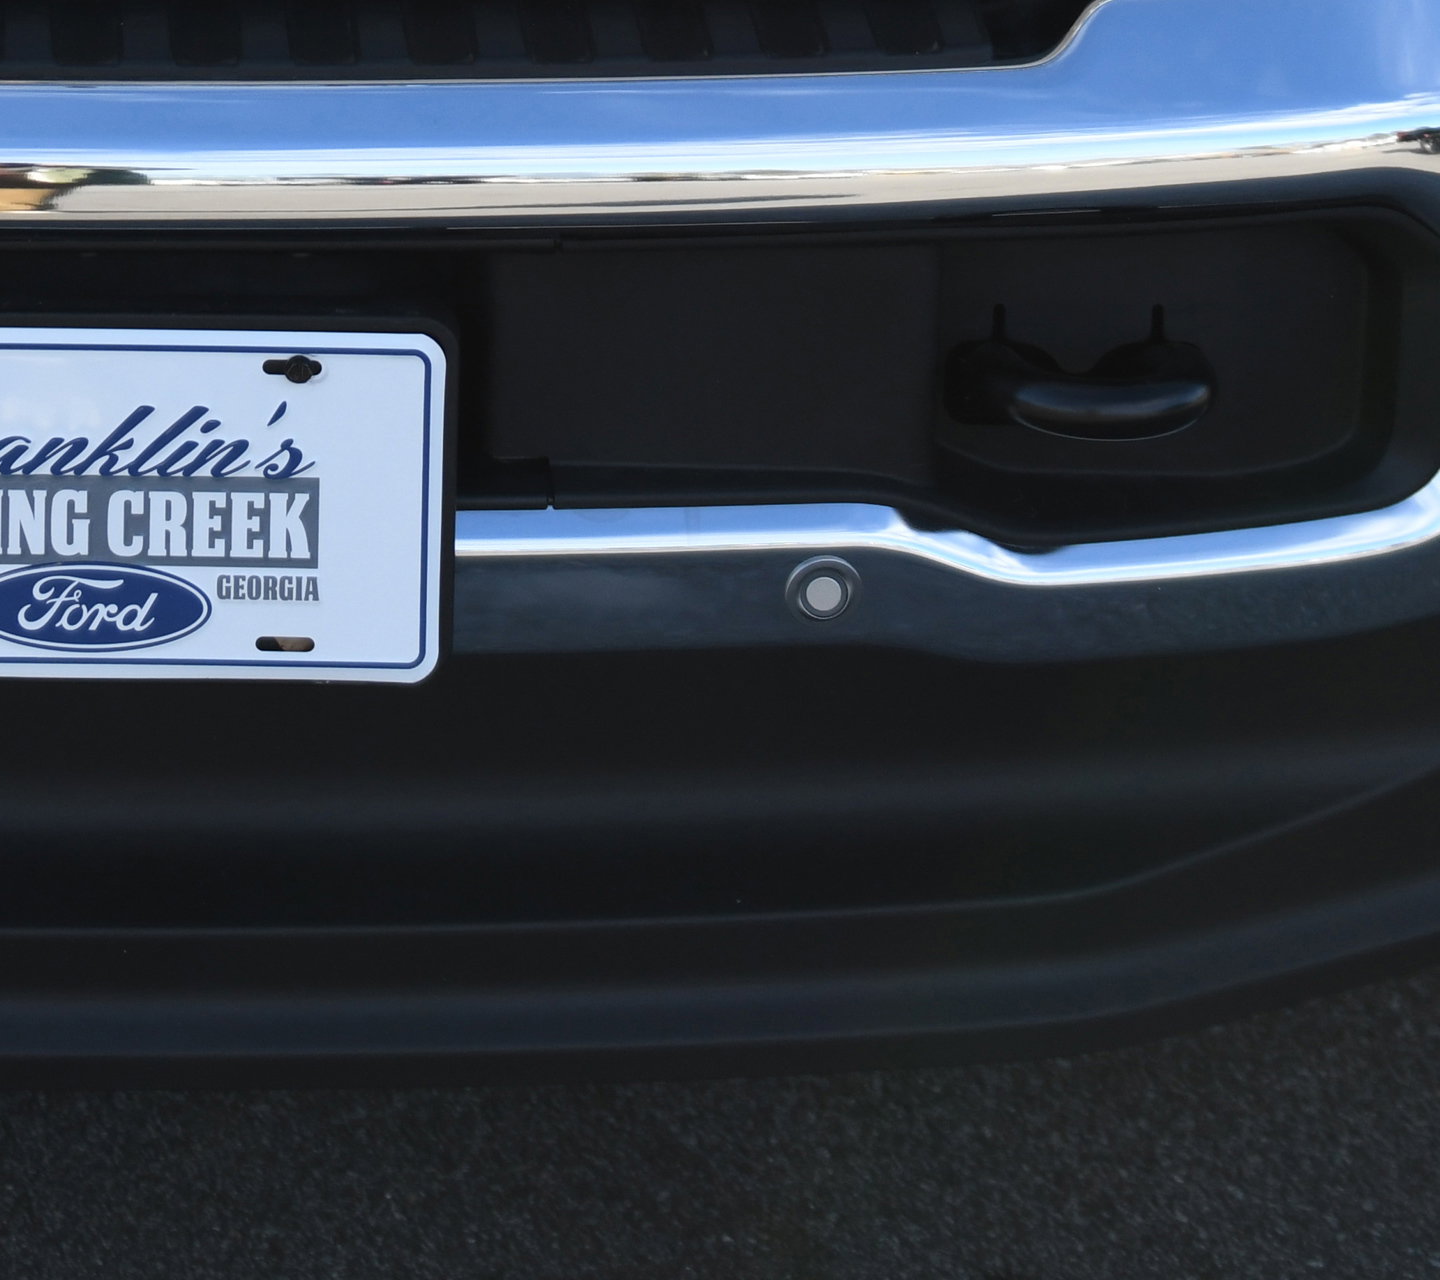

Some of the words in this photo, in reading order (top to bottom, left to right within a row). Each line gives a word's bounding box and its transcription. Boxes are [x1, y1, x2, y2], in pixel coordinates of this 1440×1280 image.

[105, 488, 312, 561] CREEK
[16, 573, 159, 633] Ford
[215, 573, 321, 603] GEORGIA
